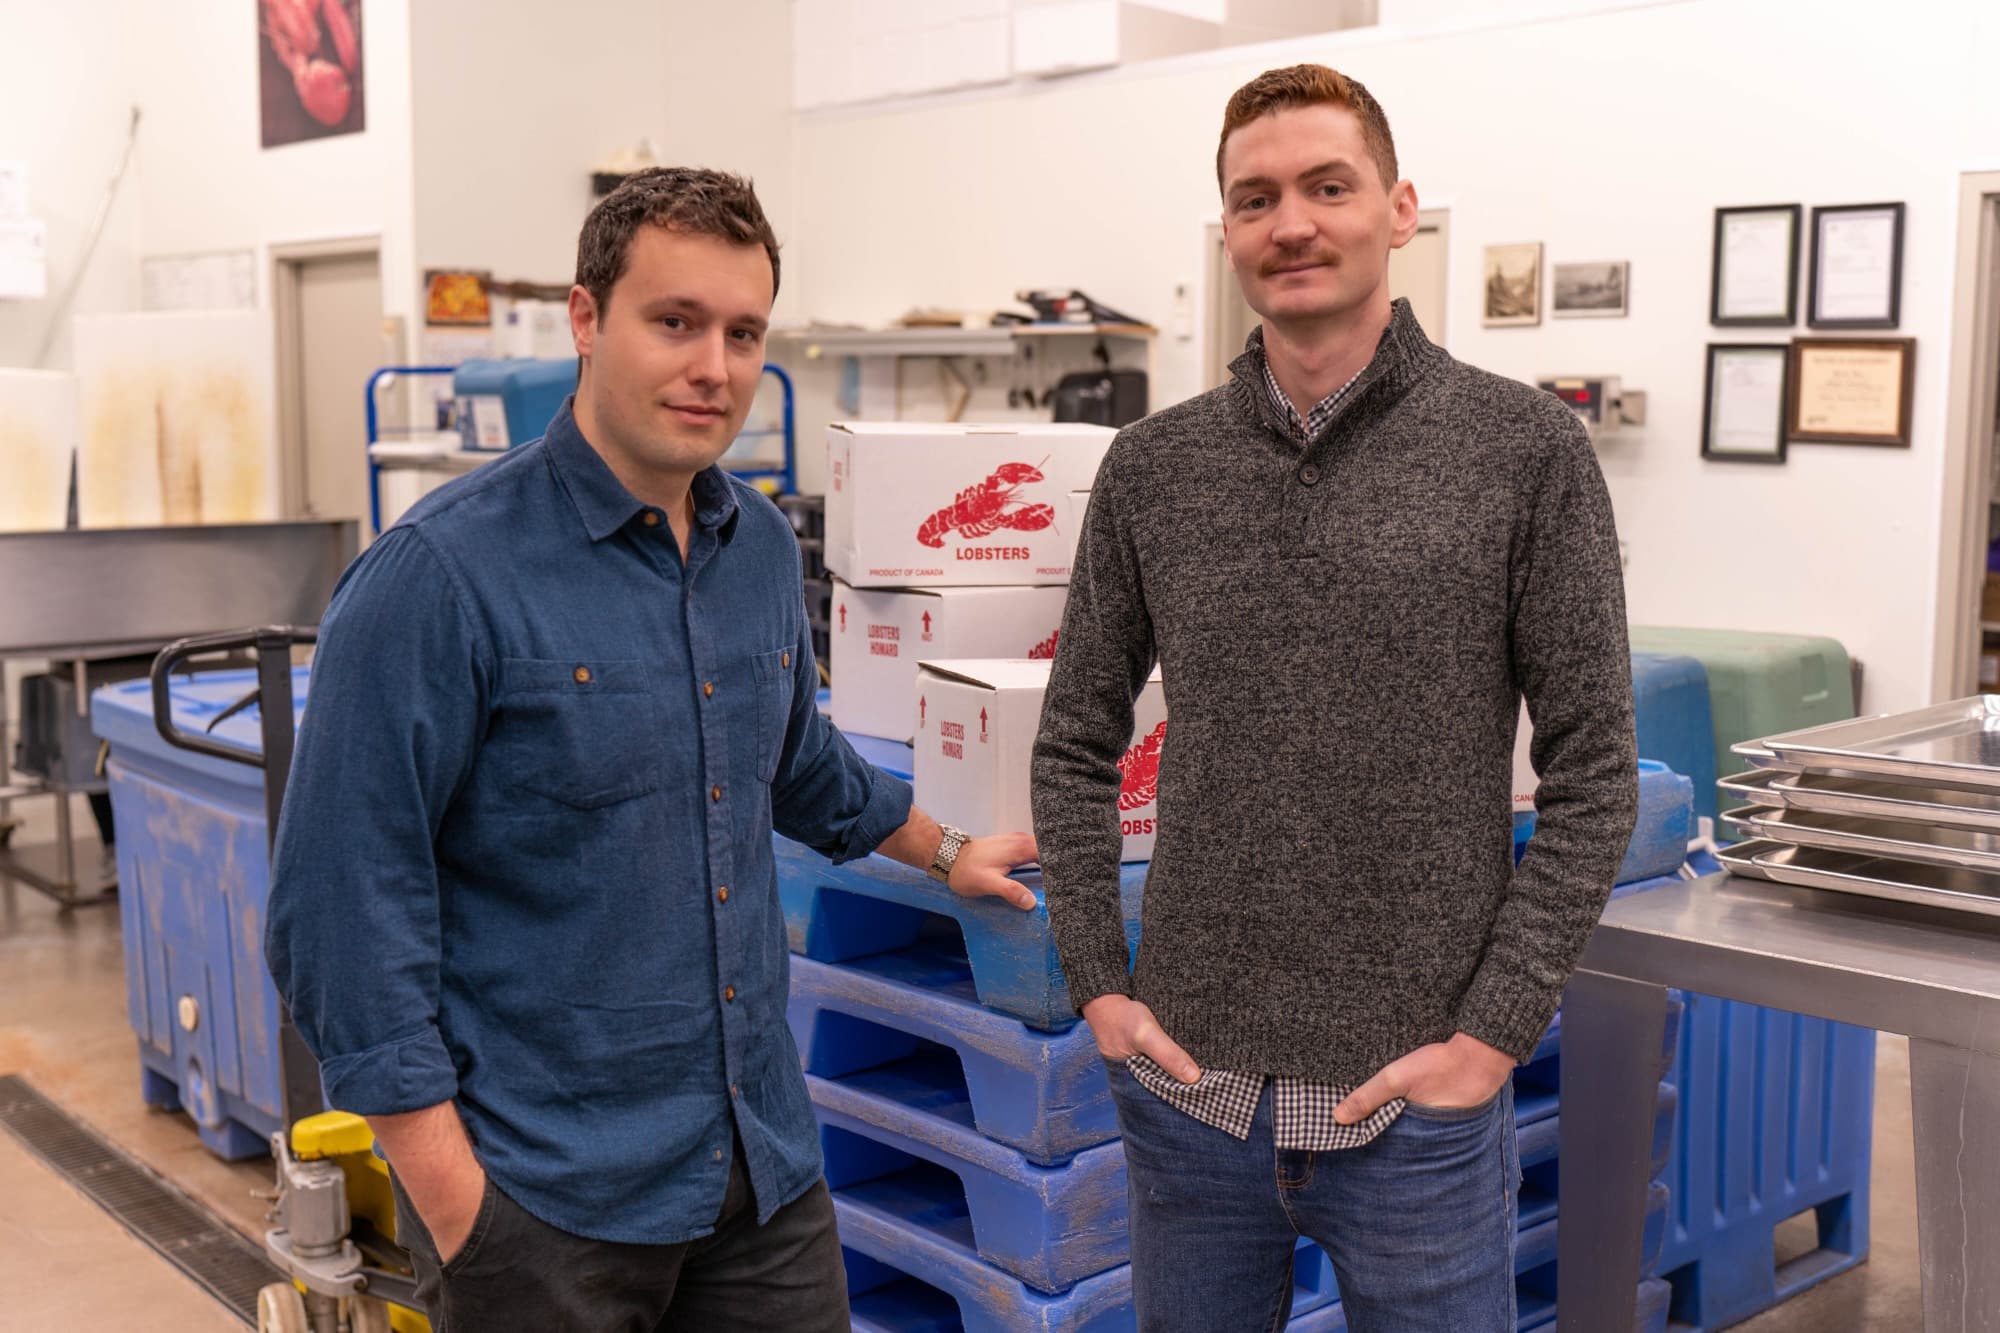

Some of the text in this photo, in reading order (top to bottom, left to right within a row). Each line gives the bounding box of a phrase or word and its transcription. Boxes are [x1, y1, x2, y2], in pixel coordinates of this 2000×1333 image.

[956, 547, 1030, 560] LOBSTERS
[869, 568, 944, 576] PRODUCT OF CANADA
[1036, 567, 1066, 575] PRODUIT
[868, 624, 900, 640] LOBSTERS
[941, 720, 964, 740] LOBSTERS
